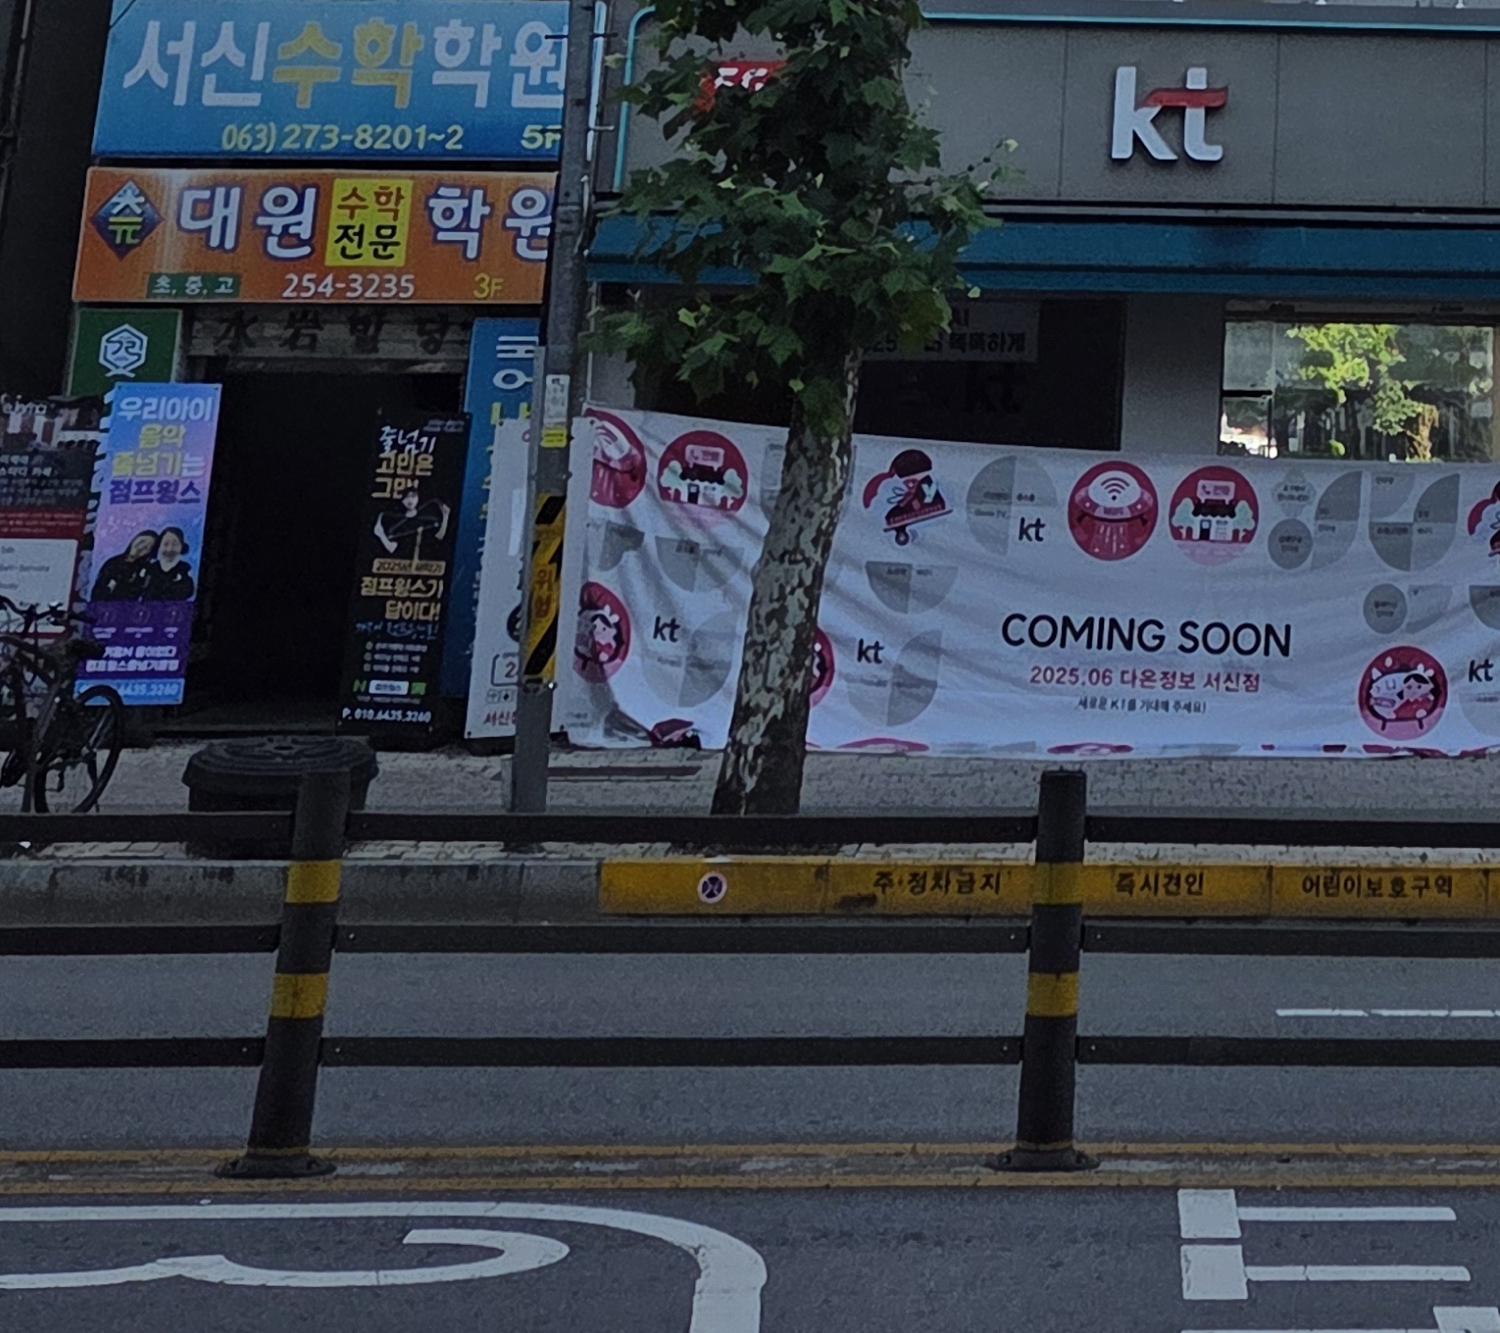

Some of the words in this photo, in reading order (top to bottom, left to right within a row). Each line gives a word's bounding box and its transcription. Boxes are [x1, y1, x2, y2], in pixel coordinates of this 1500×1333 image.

[123, 17, 568, 109] 서신수학학원
[1111, 64, 1229, 162] kt
[336, 186, 405, 216] 수학
[179, 184, 318, 259] 대원
[427, 186, 553, 262] 학원
[333, 224, 401, 261] 전문
[281, 273, 416, 299] 254-3235
[472, 274, 504, 299] 3F
[117, 395, 213, 421] 우리아이
[138, 423, 187, 448] 음악
[111, 450, 207, 478] 줄넘기는
[375, 452, 435, 477] 고민은
[108, 479, 201, 505] 점프윙스
[1018, 516, 1046, 544] kt
[651, 616, 681, 644] kt
[1001, 613, 1165, 653] COMING
[1177, 620, 1293, 658] SOON
[856, 638, 884, 666] kt
[1030, 665, 1113, 688] 2025.06
[1120, 667, 1197, 690] 다온정보
[1203, 671, 1261, 694] 서신점
[1468, 657, 1495, 683] kt
[1301, 874, 1454, 900] 어린이보호구역
